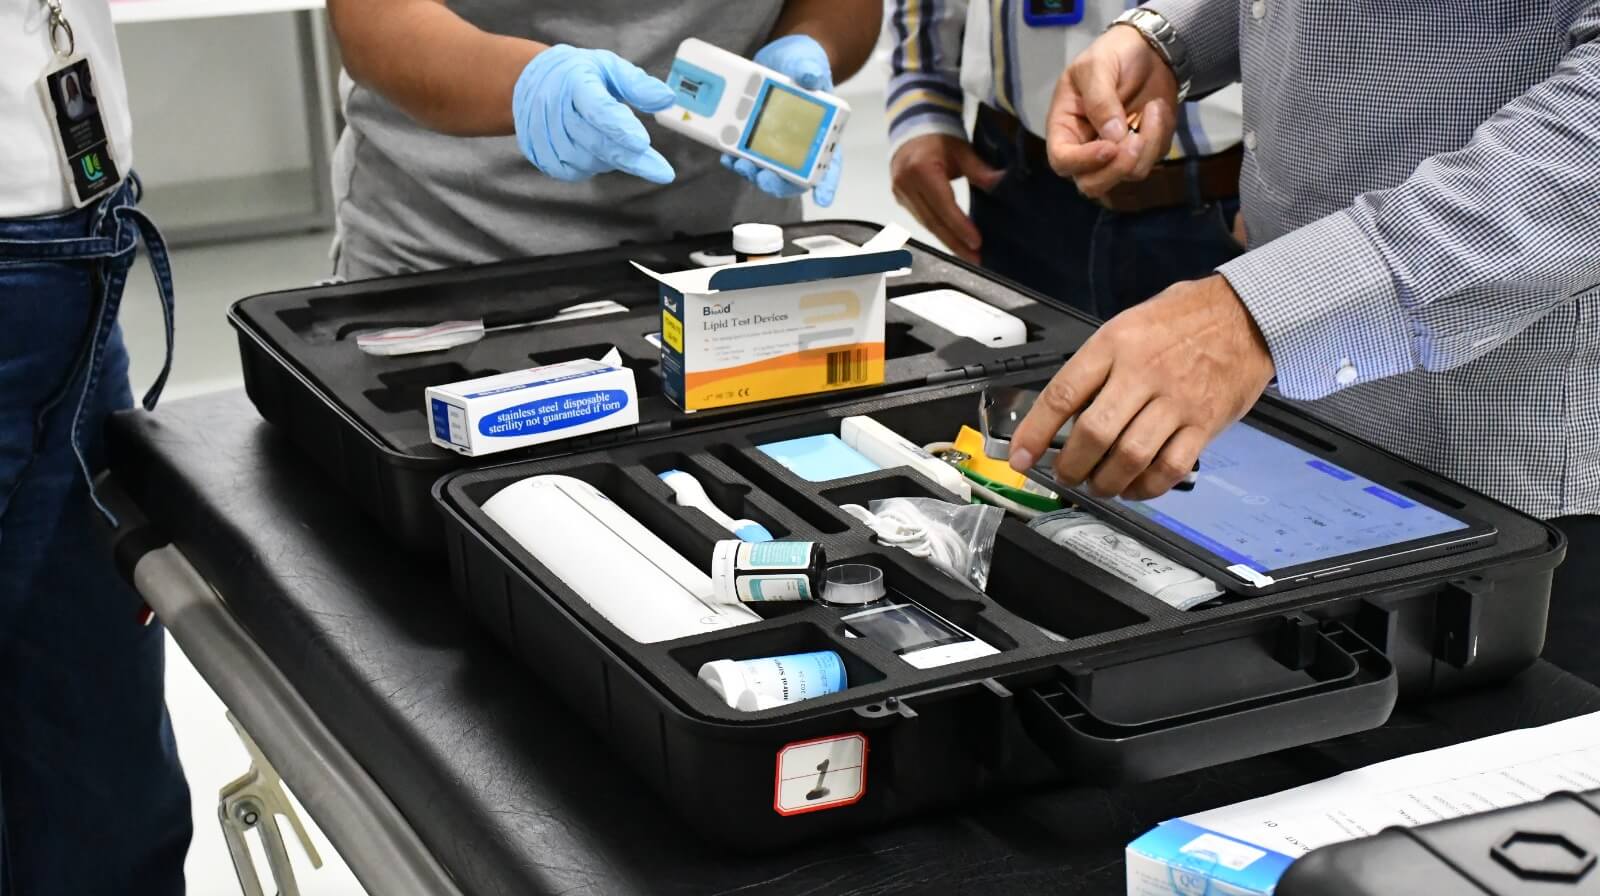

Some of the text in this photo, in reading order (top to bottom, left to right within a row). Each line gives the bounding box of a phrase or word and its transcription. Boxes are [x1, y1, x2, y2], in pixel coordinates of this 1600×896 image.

[703, 313, 789, 332] Lipid Test Devices
[488, 400, 621, 434] sterility not guaranteed if torn
[497, 391, 610, 423] stainless steel disposable
[805, 758, 831, 801] 1
